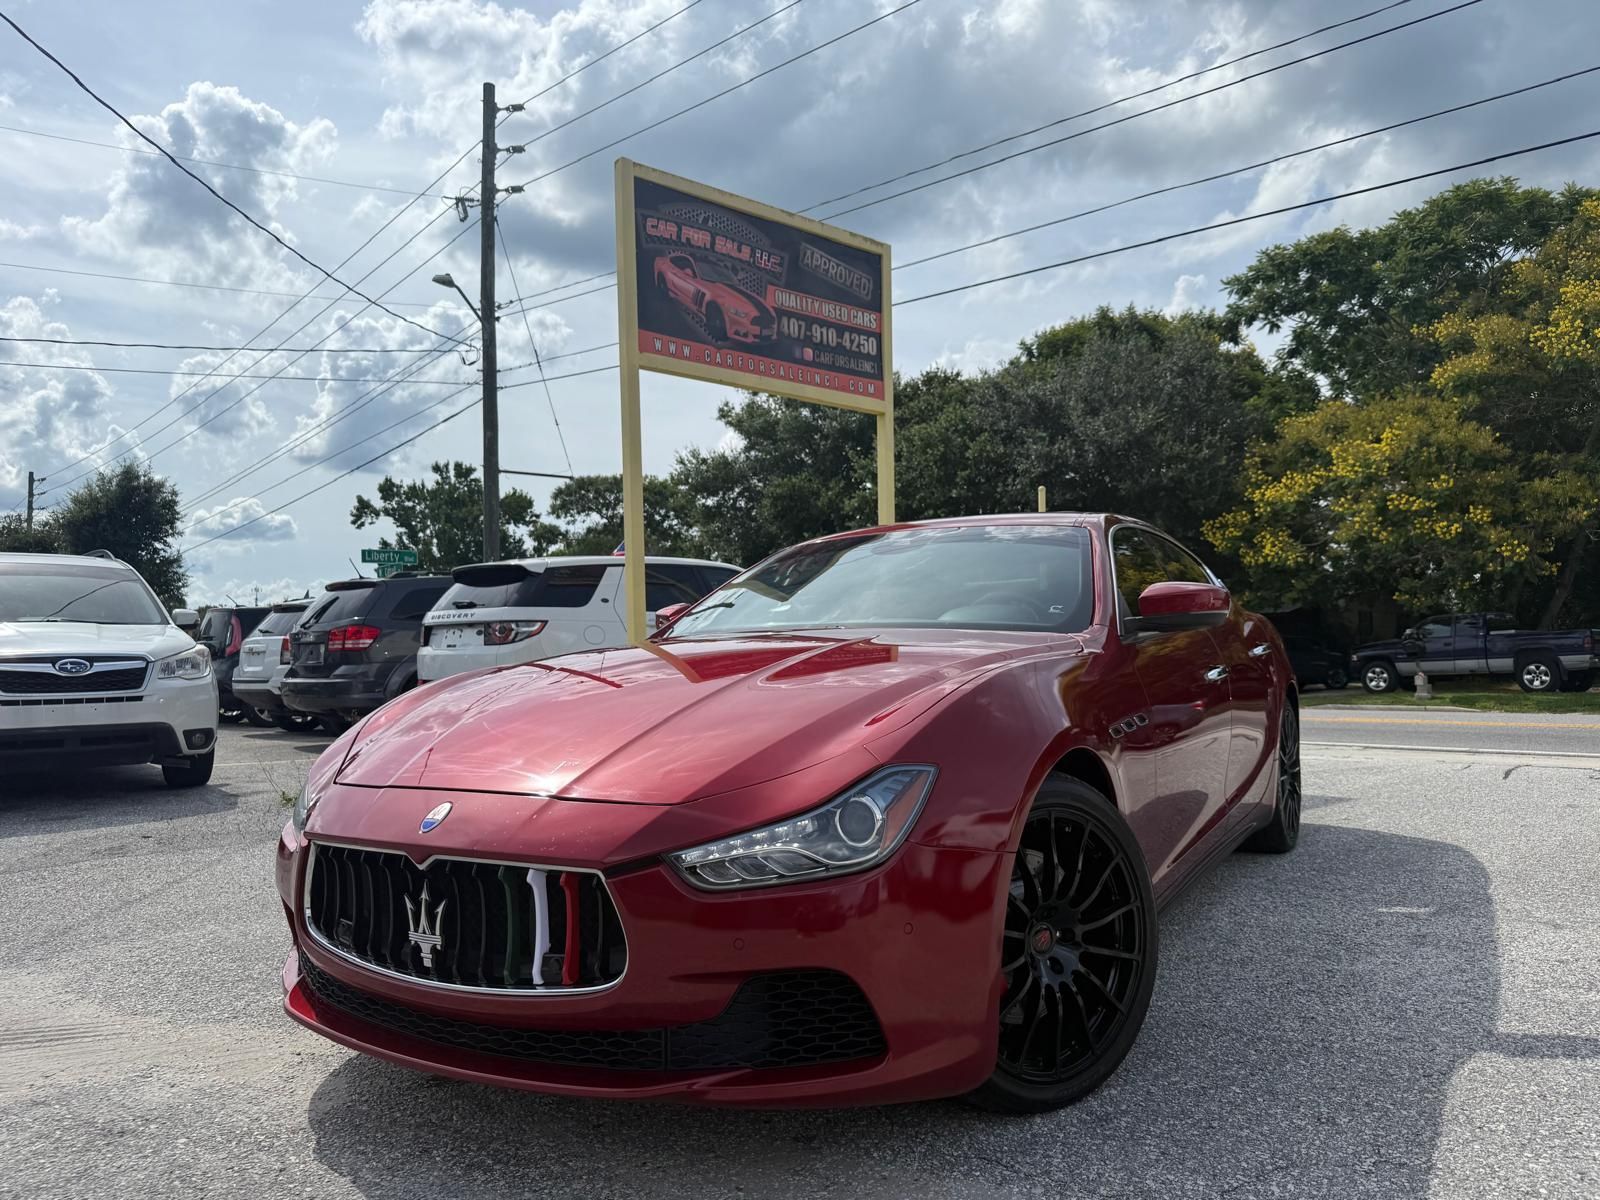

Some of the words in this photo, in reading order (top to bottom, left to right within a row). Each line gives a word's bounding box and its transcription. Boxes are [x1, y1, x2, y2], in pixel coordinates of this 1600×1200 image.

[646, 217, 678, 241] CAR
[681, 224, 711, 249] FOR
[803, 249, 869, 295] APPROVED
[775, 290, 820, 313] QUALITY
[822, 301, 848, 322] USED
[850, 309, 877, 329] CARS
[779, 315, 878, 356] 407-910-4250
[365, 551, 400, 563] Liberty
[430, 612, 477, 620] DISCOVERY
